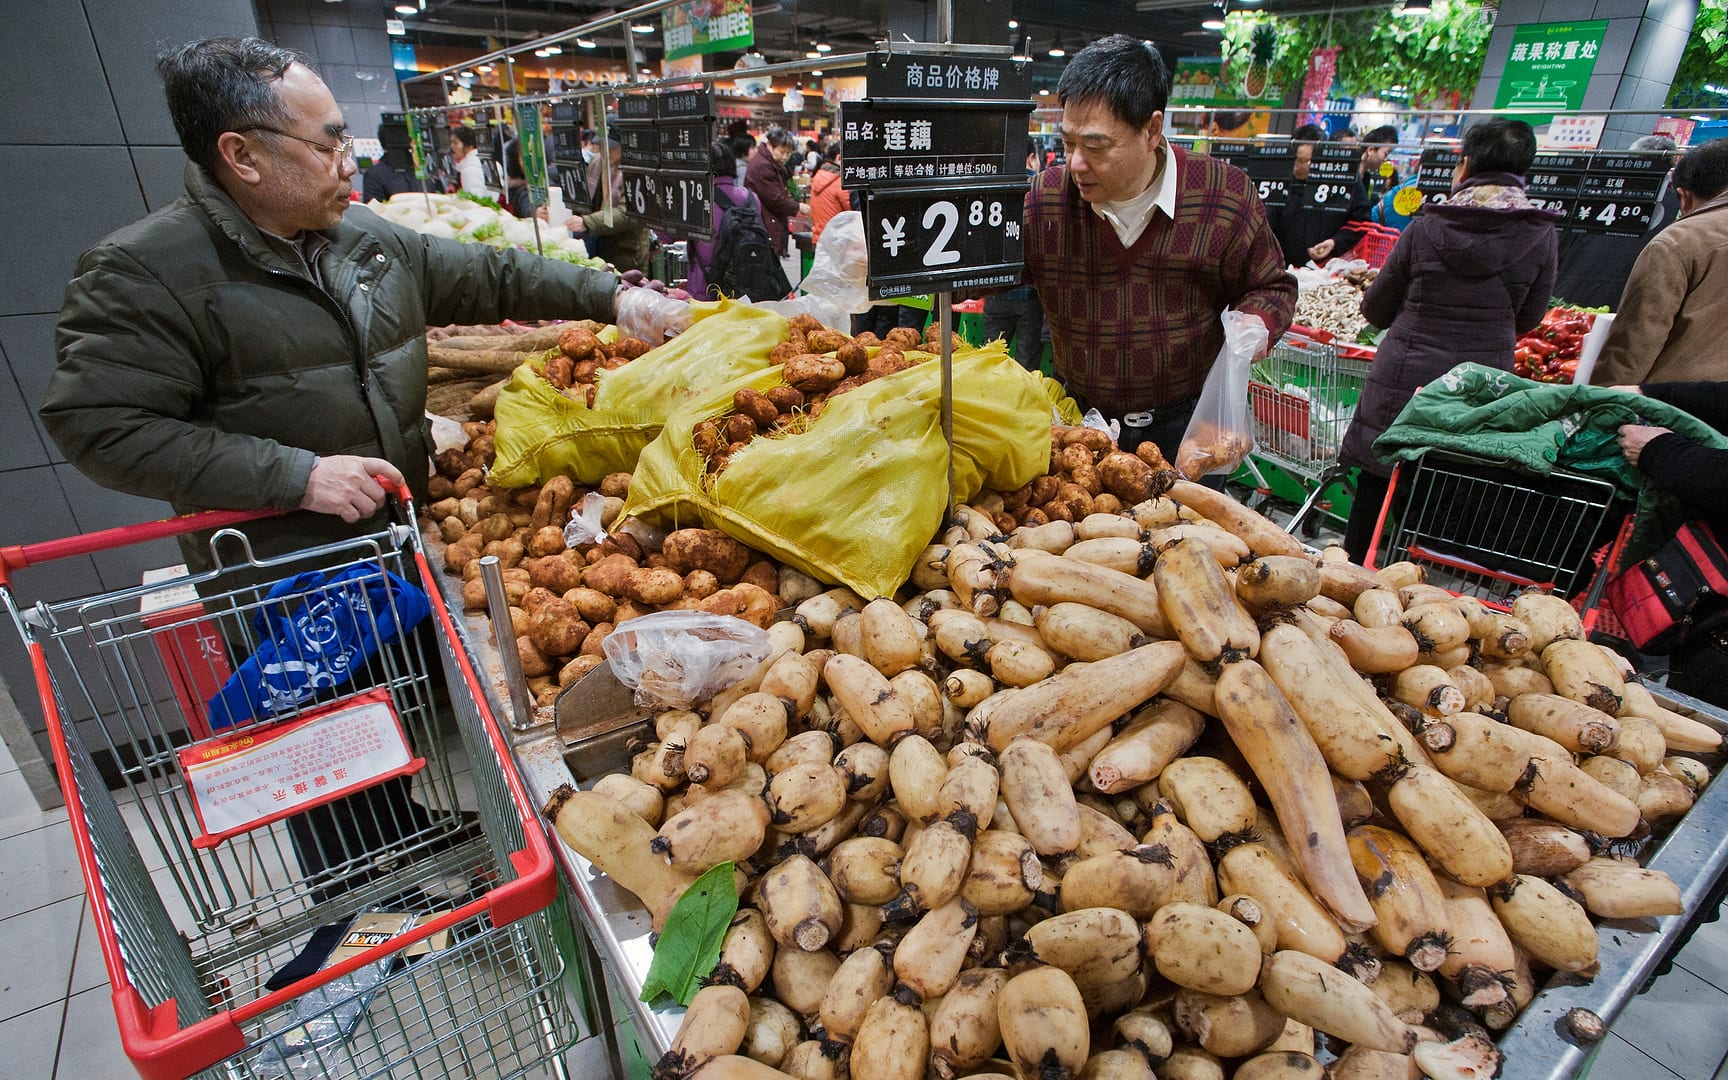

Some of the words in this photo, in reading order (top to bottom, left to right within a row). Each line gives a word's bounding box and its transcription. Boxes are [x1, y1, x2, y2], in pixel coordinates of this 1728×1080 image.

[1510, 40, 1597, 61] 蔬果称重处
[906, 63, 999, 90] 商品价格牌
[883, 120, 932, 151] 莲藕
[844, 166, 888, 180] 产地:重庆
[894, 163, 935, 178] 等级:合格
[939, 162, 998, 176] 计量单位:500g
[1005, 221, 1021, 243] 500g
[270, 766, 348, 803] 温馨提示
